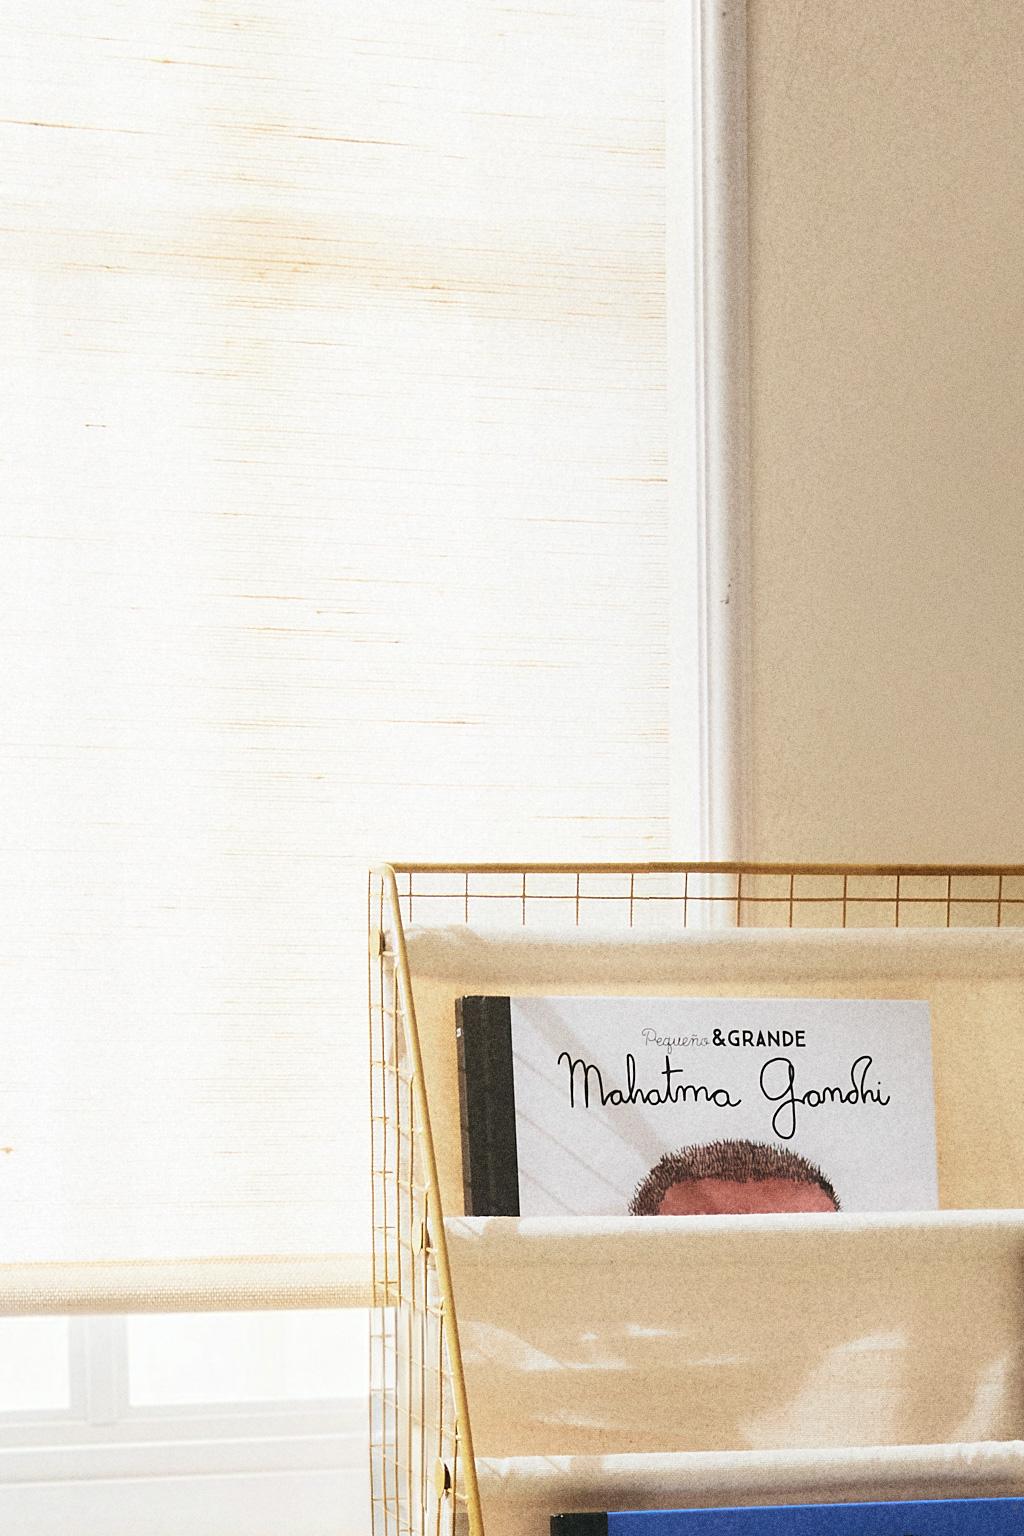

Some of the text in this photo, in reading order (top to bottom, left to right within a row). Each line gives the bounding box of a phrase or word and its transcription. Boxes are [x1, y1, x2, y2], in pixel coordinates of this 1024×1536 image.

[641, 1027, 710, 1054] Pequeño
[557, 1051, 891, 1140] Mahatma Gandhi
